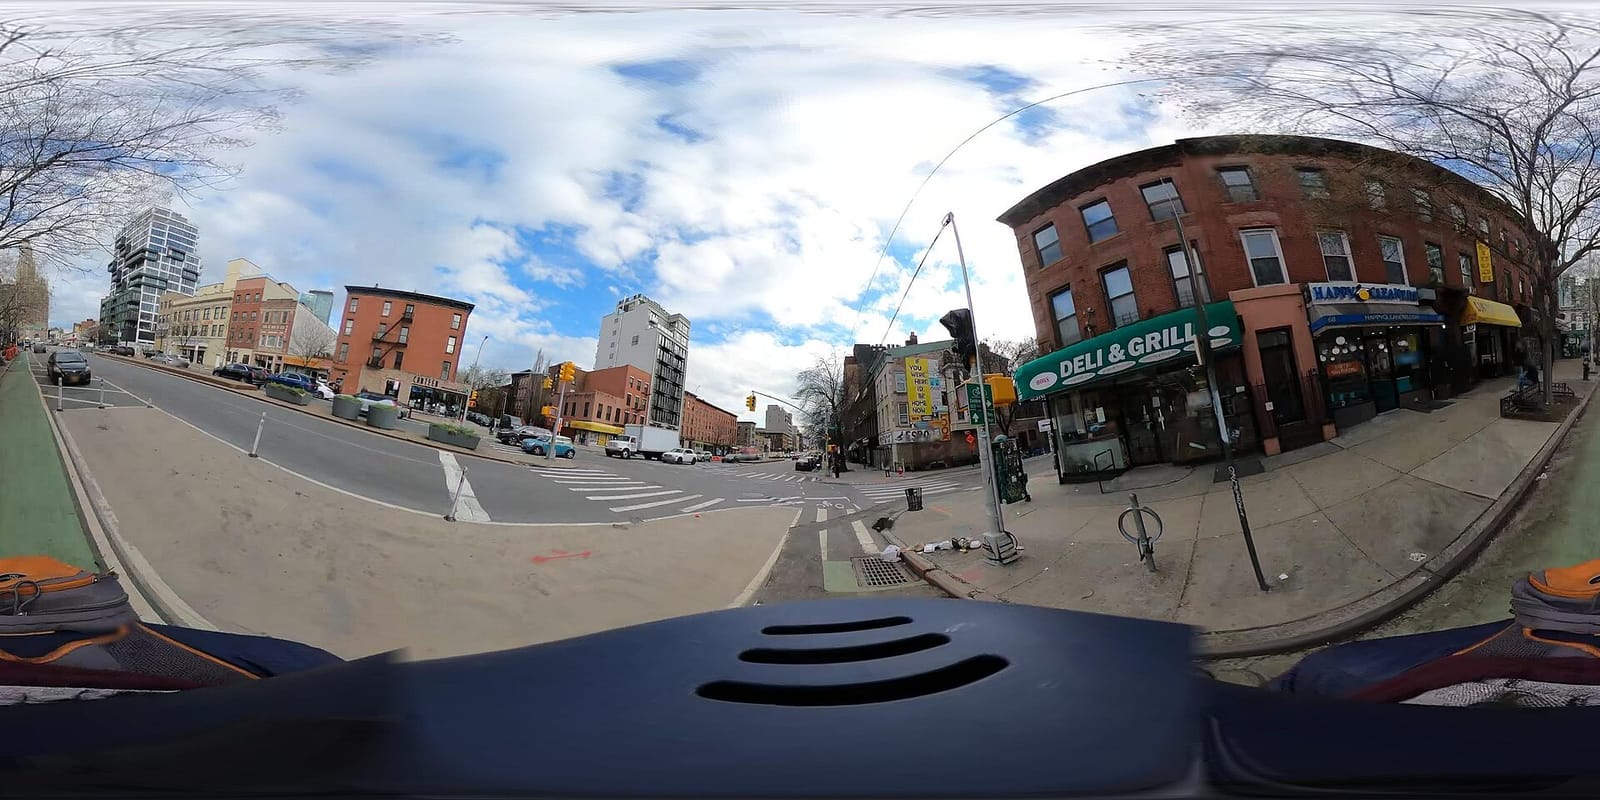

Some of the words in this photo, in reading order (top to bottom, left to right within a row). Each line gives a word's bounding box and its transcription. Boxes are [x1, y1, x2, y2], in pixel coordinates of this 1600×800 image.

[1312, 286, 1356, 300] HAPPY
[1060, 349, 1103, 378] DELI
[1108, 343, 1126, 363] &
[1127, 322, 1197, 357] GRILL
